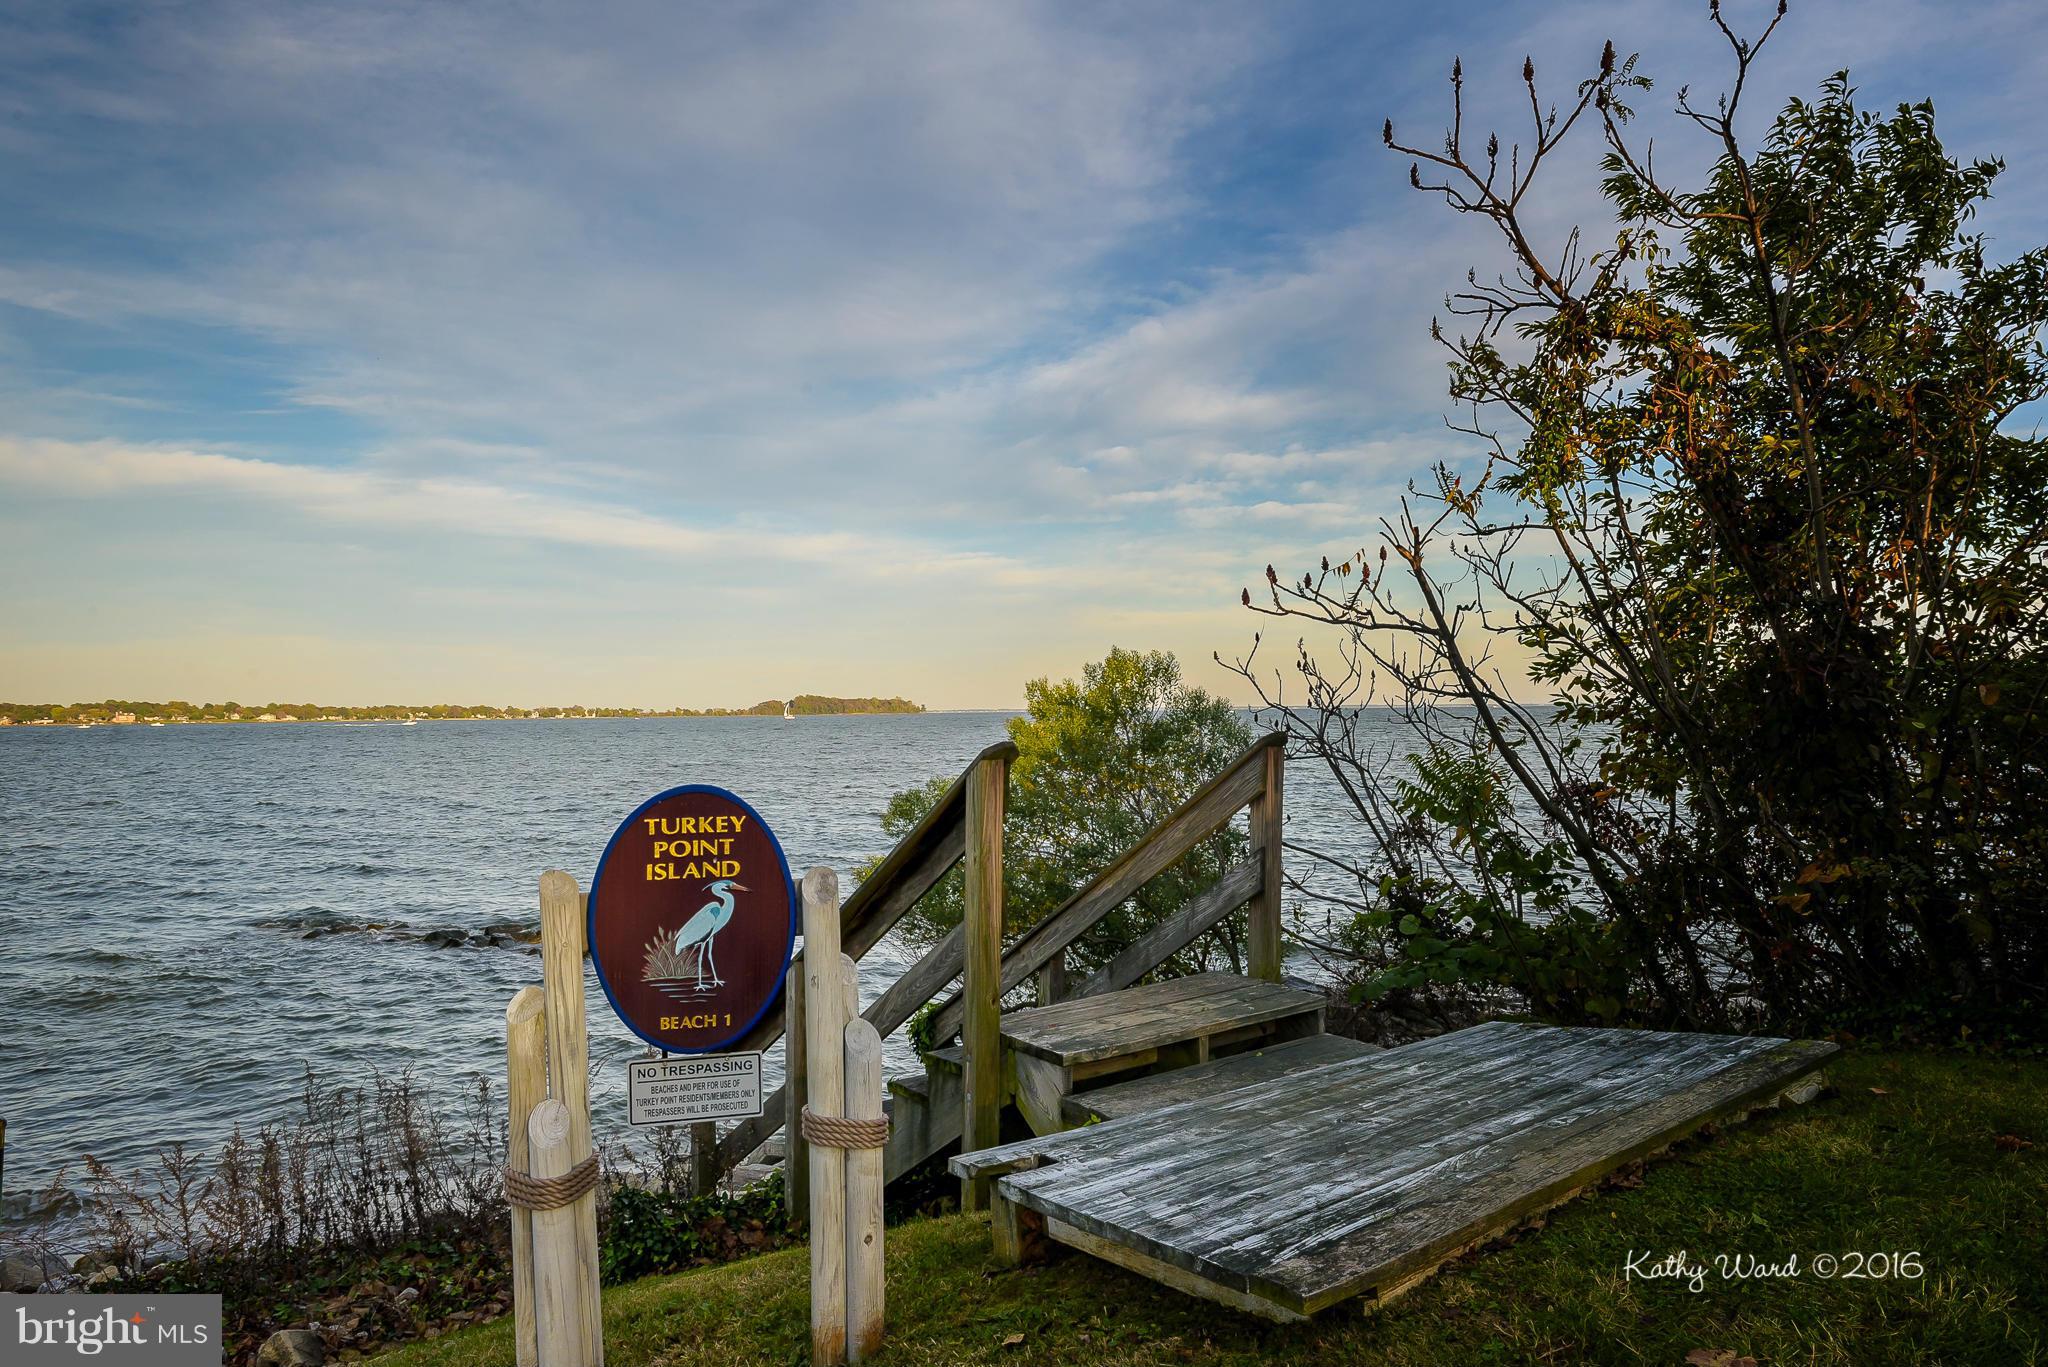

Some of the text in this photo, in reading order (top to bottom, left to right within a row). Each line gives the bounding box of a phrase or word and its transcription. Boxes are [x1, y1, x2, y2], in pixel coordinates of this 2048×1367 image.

[644, 816, 746, 836] TURKEY
[654, 838, 734, 858] POINT
[646, 860, 741, 880] ISLAND
[660, 1014, 730, 1030] BEACH 1
[638, 1060, 752, 1078] NO TRESPASSING
[650, 1079, 740, 1094] BEACHES AND PIER FOR USE OF
[636, 1089, 755, 1107] TURKEY POINT RESIDENTS/MEMBERS ONLY
[644, 1101, 748, 1118] TRESPASSERS WILL BE PROSECUTED
